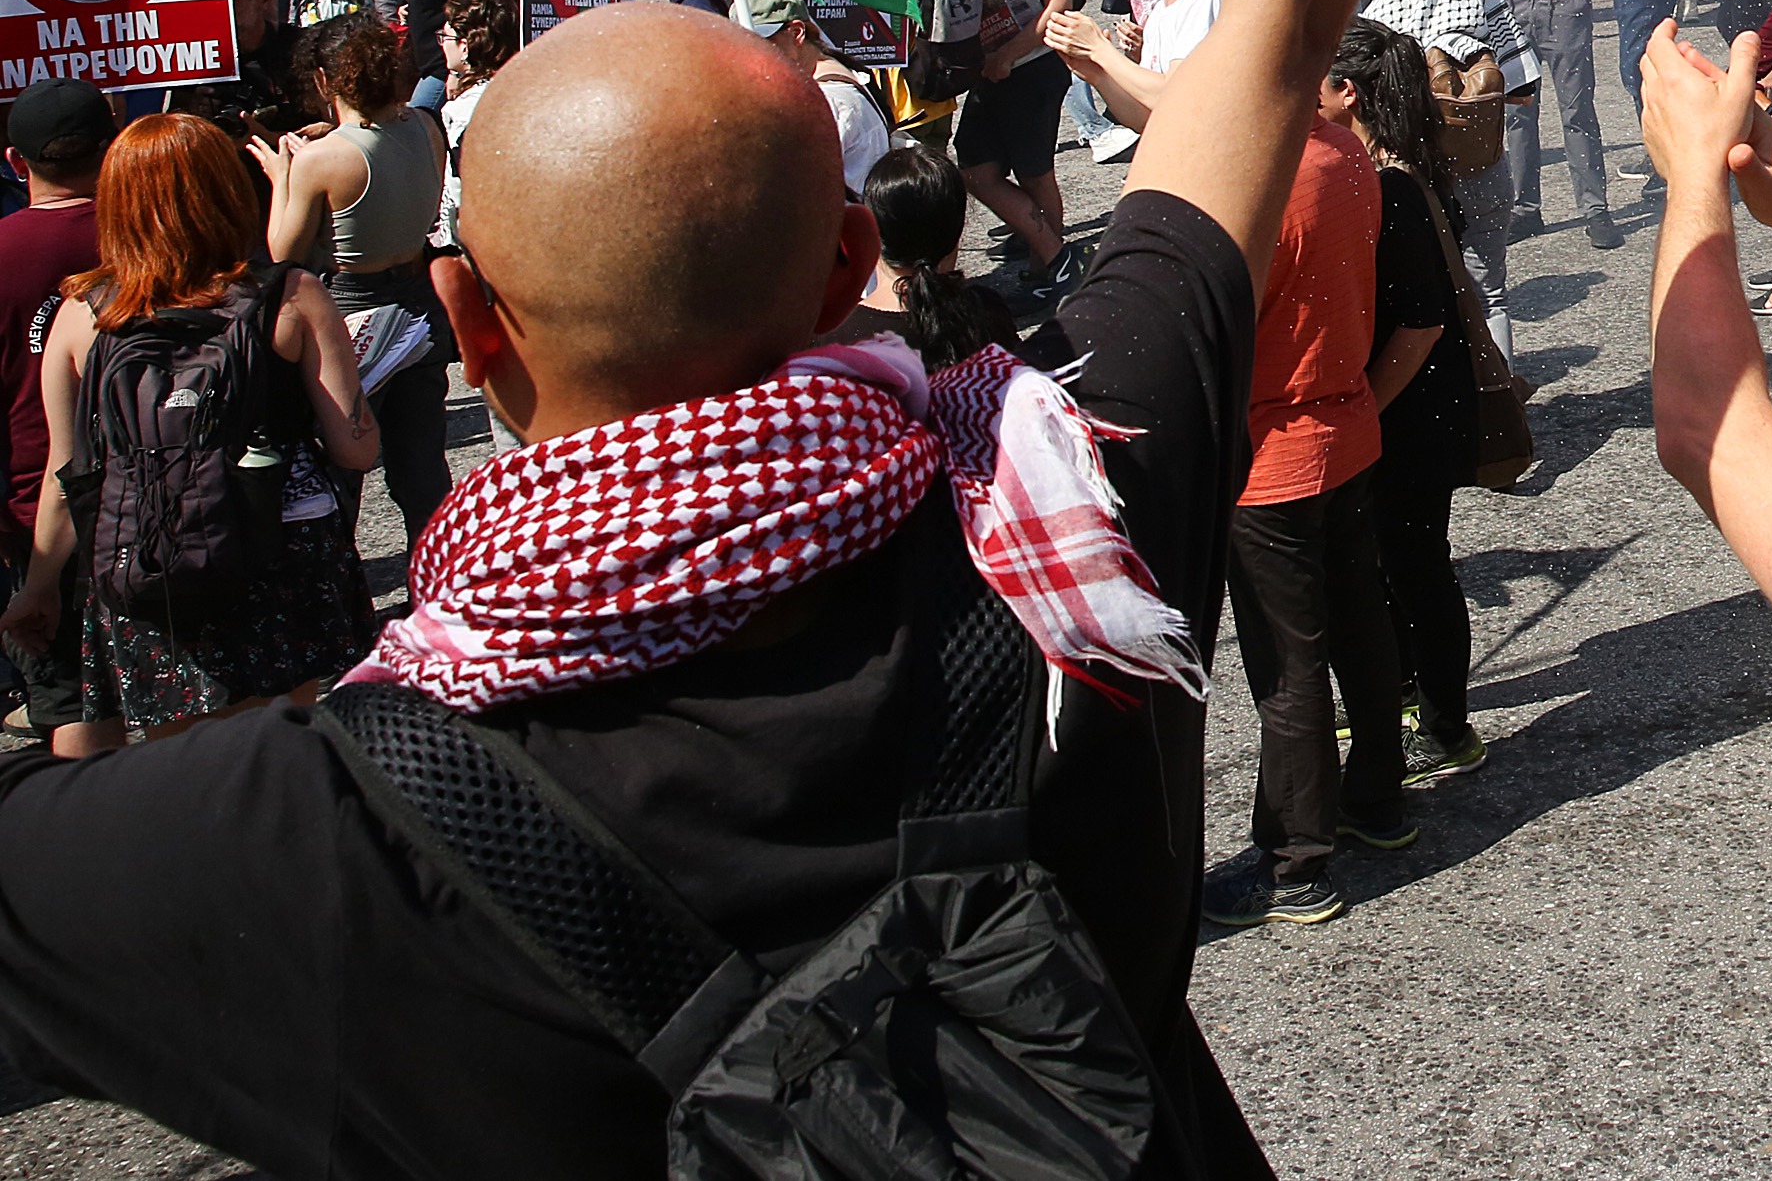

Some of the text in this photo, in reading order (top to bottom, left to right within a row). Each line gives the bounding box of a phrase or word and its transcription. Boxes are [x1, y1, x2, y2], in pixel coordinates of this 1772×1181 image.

[37, 9, 159, 50] ΝΑ ΤΗΝ
[817, 8, 846, 18] ΙΣΡΑΗΛ
[29, 295, 61, 354] ΕΛΕΥΘΕΡΑ
